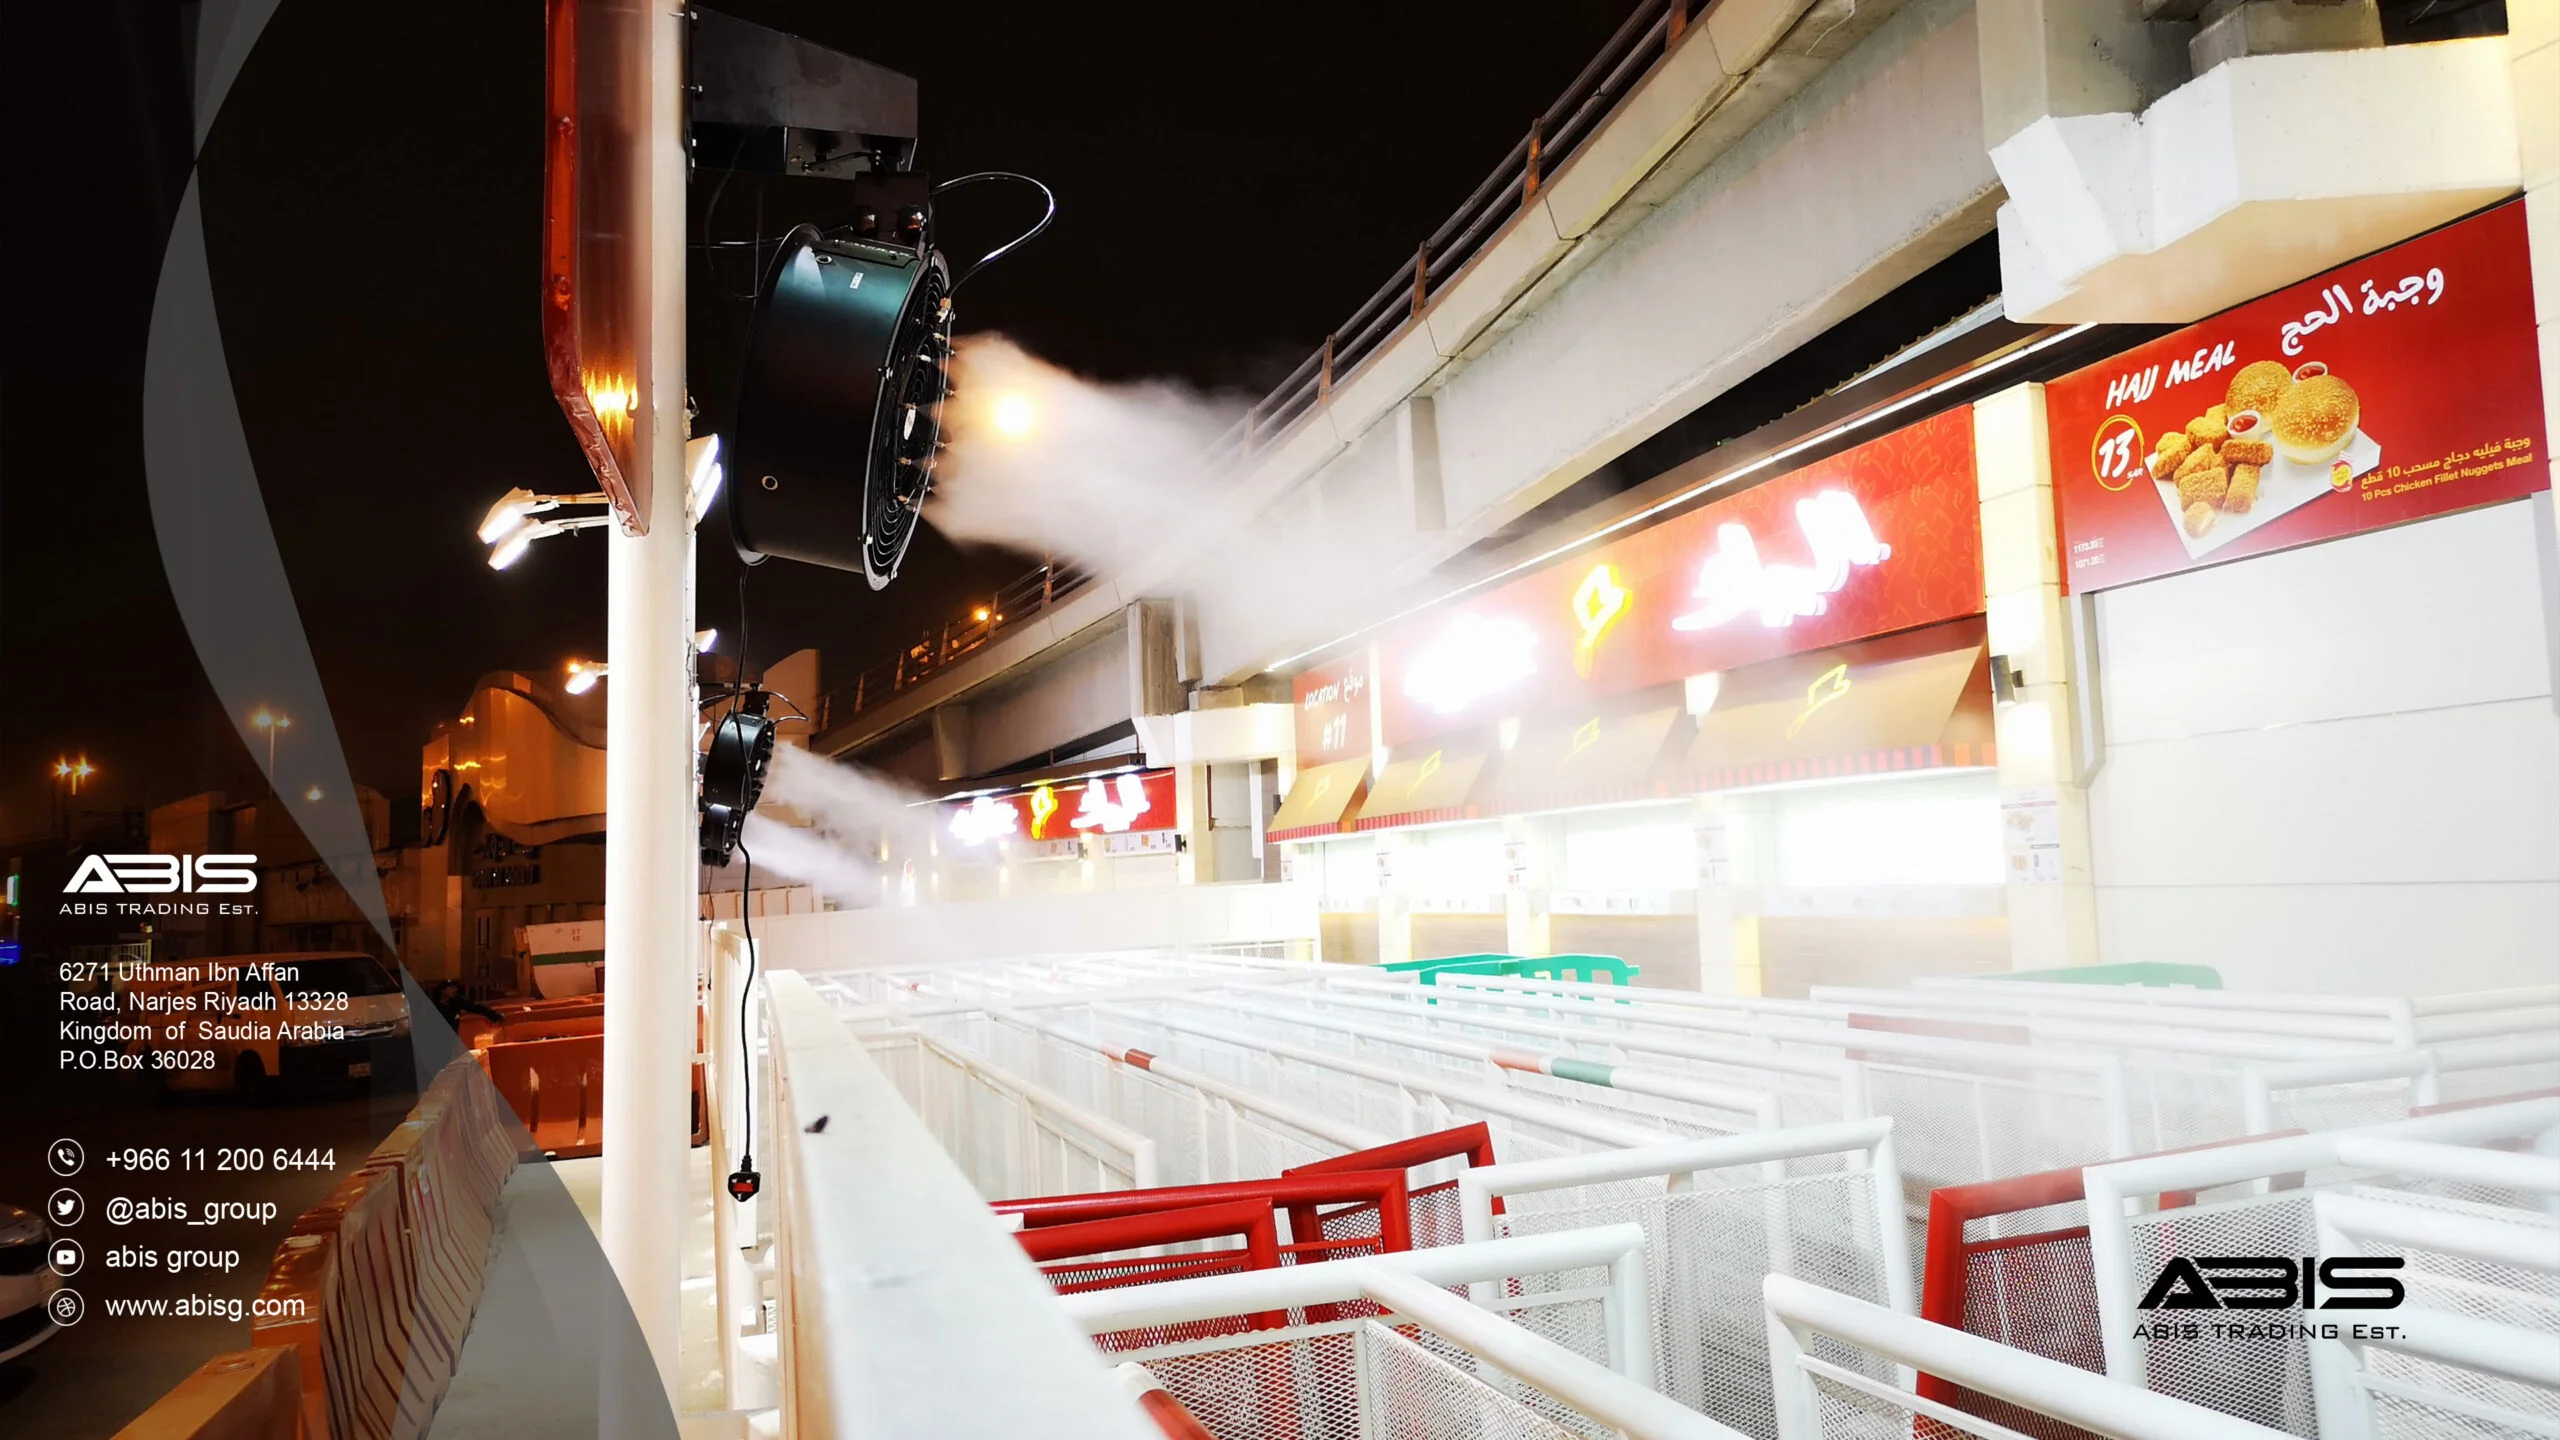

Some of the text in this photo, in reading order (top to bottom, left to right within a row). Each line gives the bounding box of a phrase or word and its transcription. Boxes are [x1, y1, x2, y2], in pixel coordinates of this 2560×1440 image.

[2281, 268, 2444, 356] وجبة الحج
[2106, 340, 2236, 410] HAJJ MEAL
[2098, 427, 2136, 479] 13
[2443, 451, 2470, 470] دجاج
[2504, 436, 2531, 452] وجبة
[2360, 471, 2384, 490] قطع
[2361, 453, 2533, 502] 10 Pcs Chicken Fillet Nuggets Meal
[2386, 465, 2401, 479] 10
[1304, 680, 1340, 711] LOCATION
[1322, 713, 1347, 752] #11
